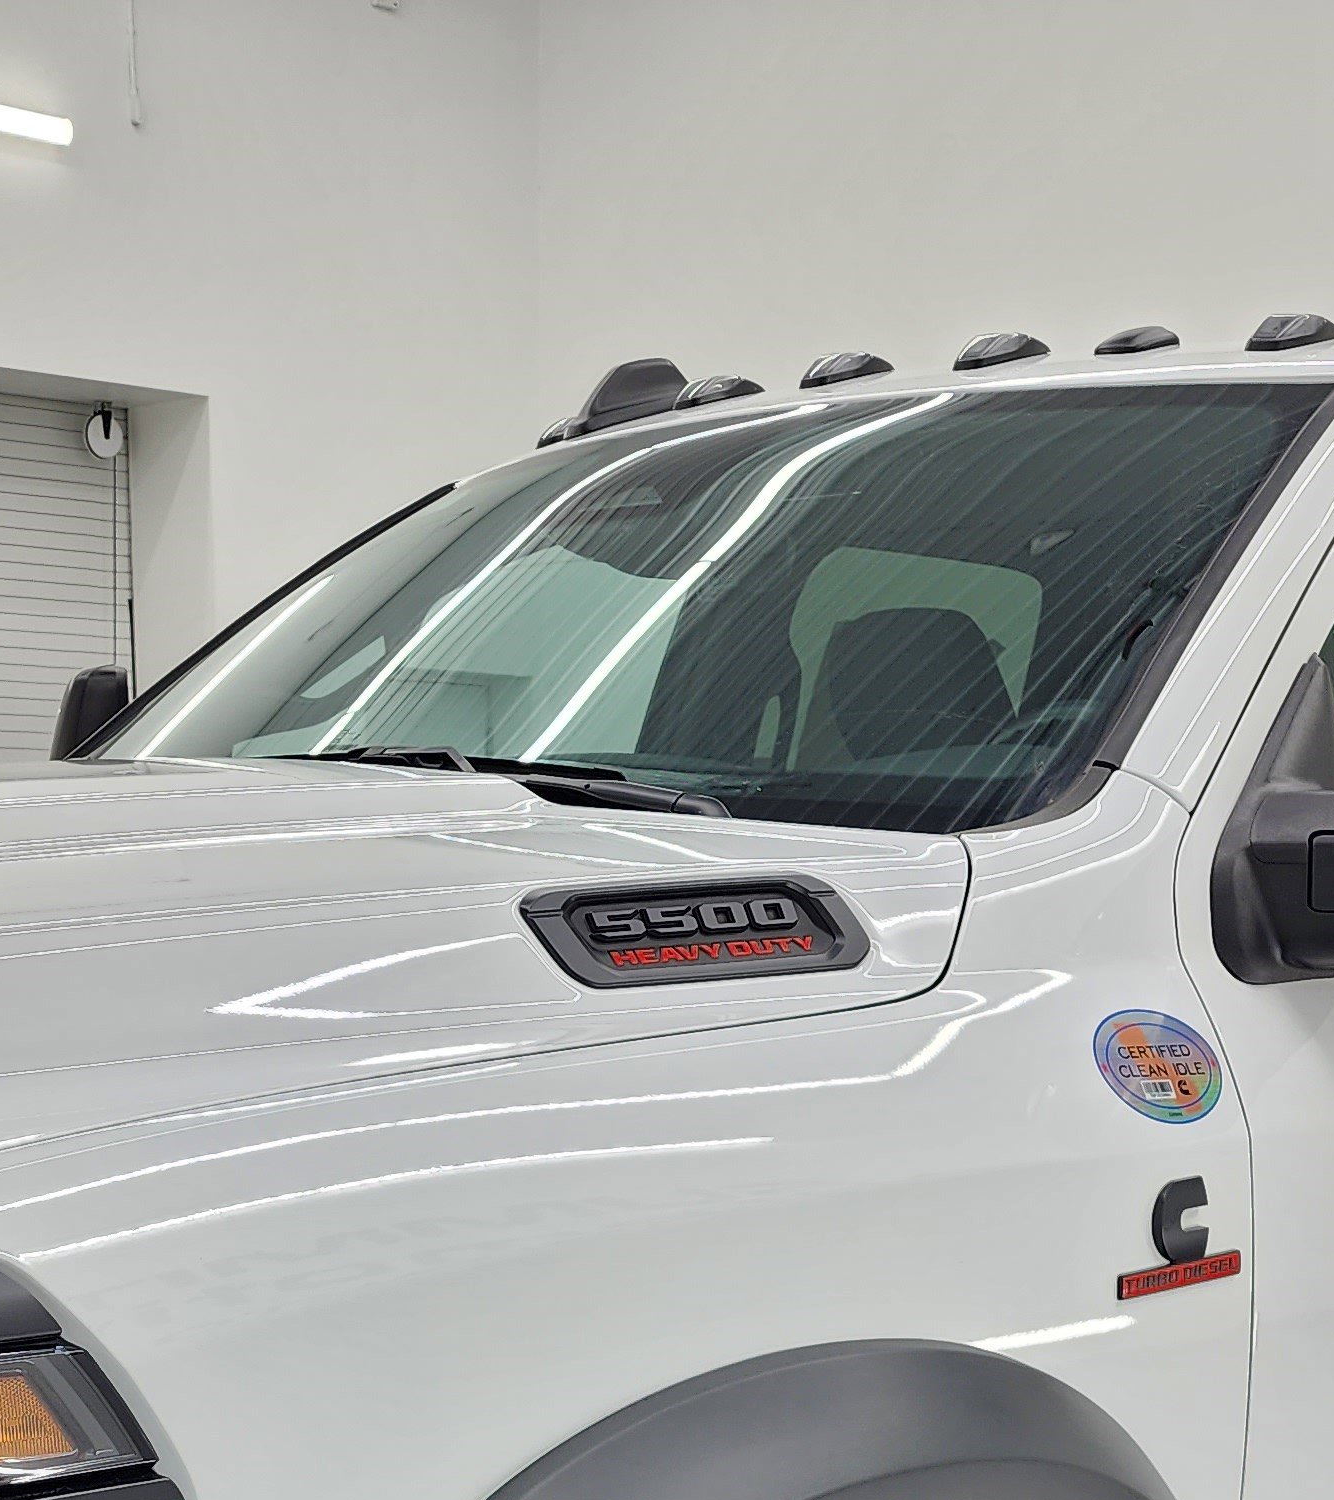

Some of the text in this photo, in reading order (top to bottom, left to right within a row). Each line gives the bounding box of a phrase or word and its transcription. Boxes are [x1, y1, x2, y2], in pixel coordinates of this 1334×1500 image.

[585, 898, 799, 942] 5500
[608, 936, 814, 967] HEAVY DUTY
[1117, 1043, 1191, 1060] CERTIFIED
[1118, 1061, 1206, 1078] CLEAN IDLE
[1124, 1257, 1236, 1295] TURBO DIESEL
